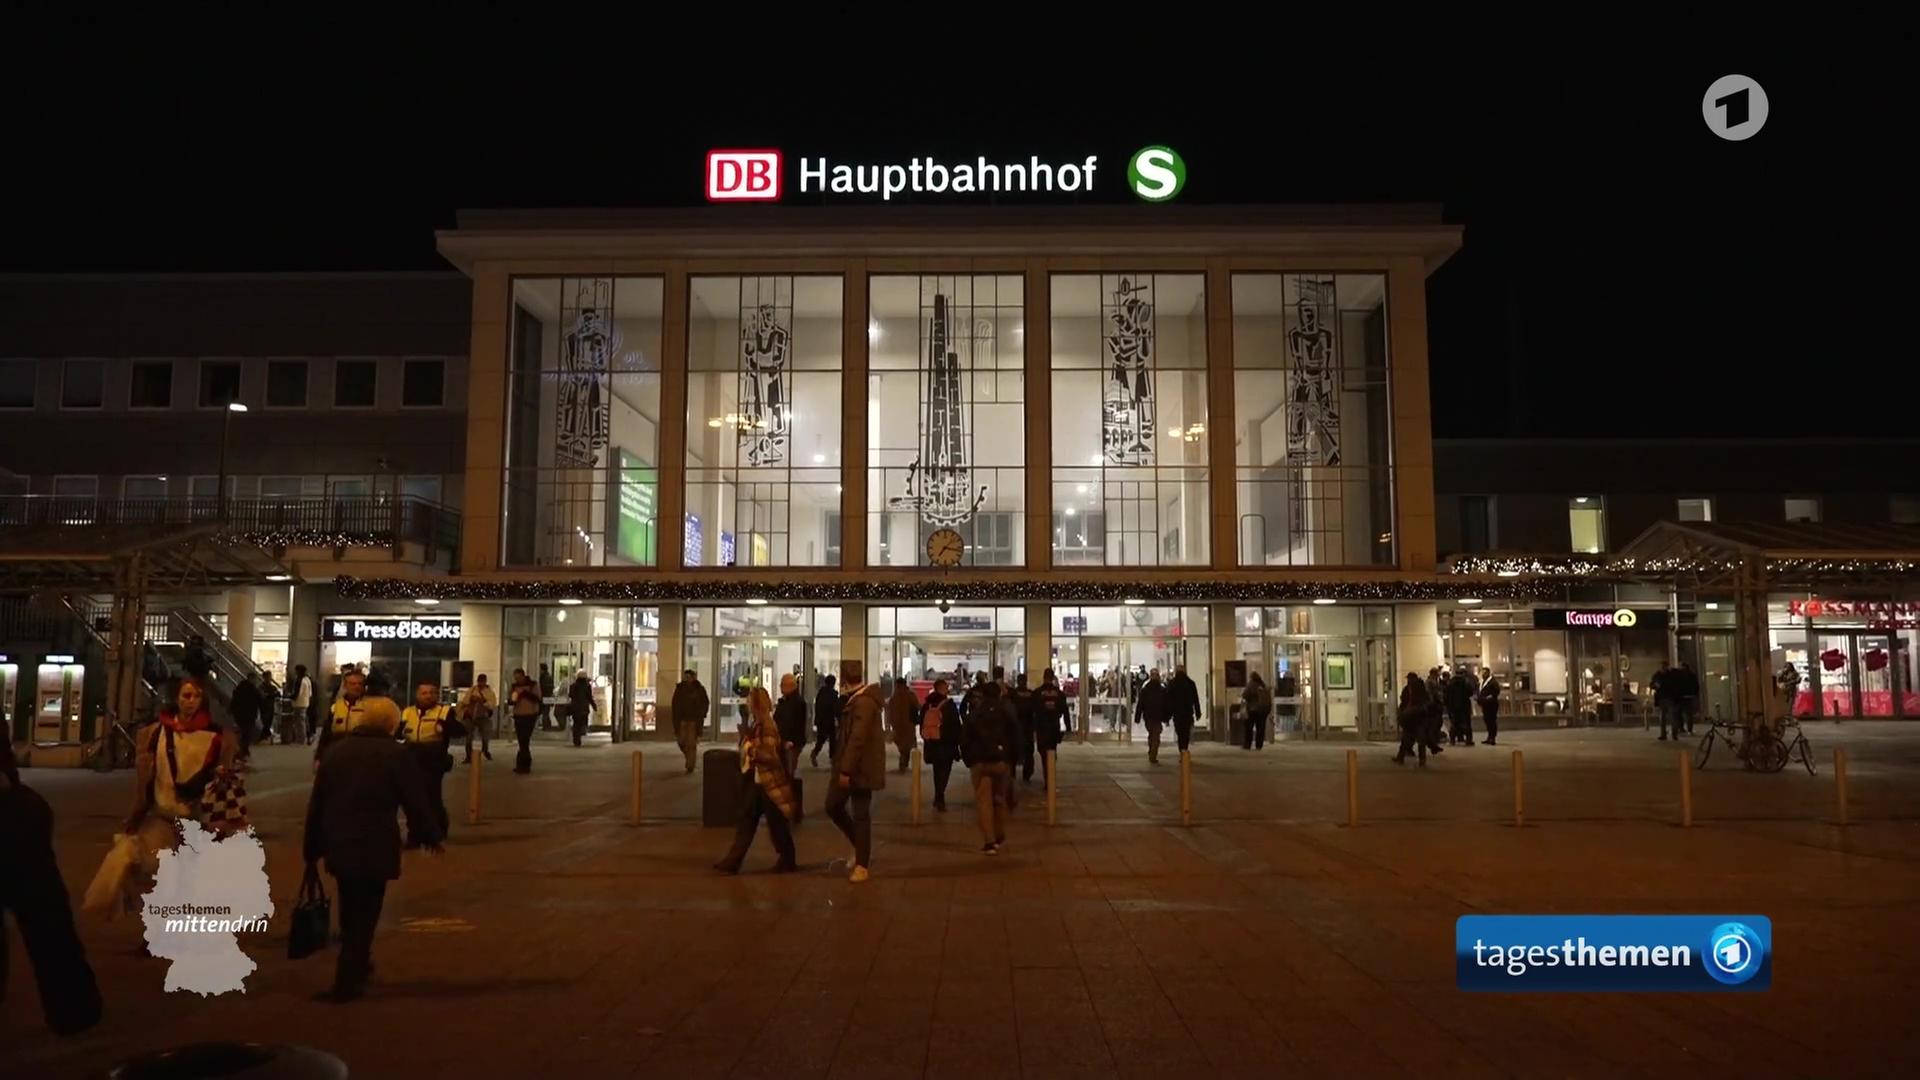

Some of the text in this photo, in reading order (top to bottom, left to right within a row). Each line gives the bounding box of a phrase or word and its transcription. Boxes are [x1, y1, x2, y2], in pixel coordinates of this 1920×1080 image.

[716, 155, 1097, 200] DB Hauptbahnhof
[1136, 149, 1178, 198] S
[1566, 611, 1612, 627] Kamps
